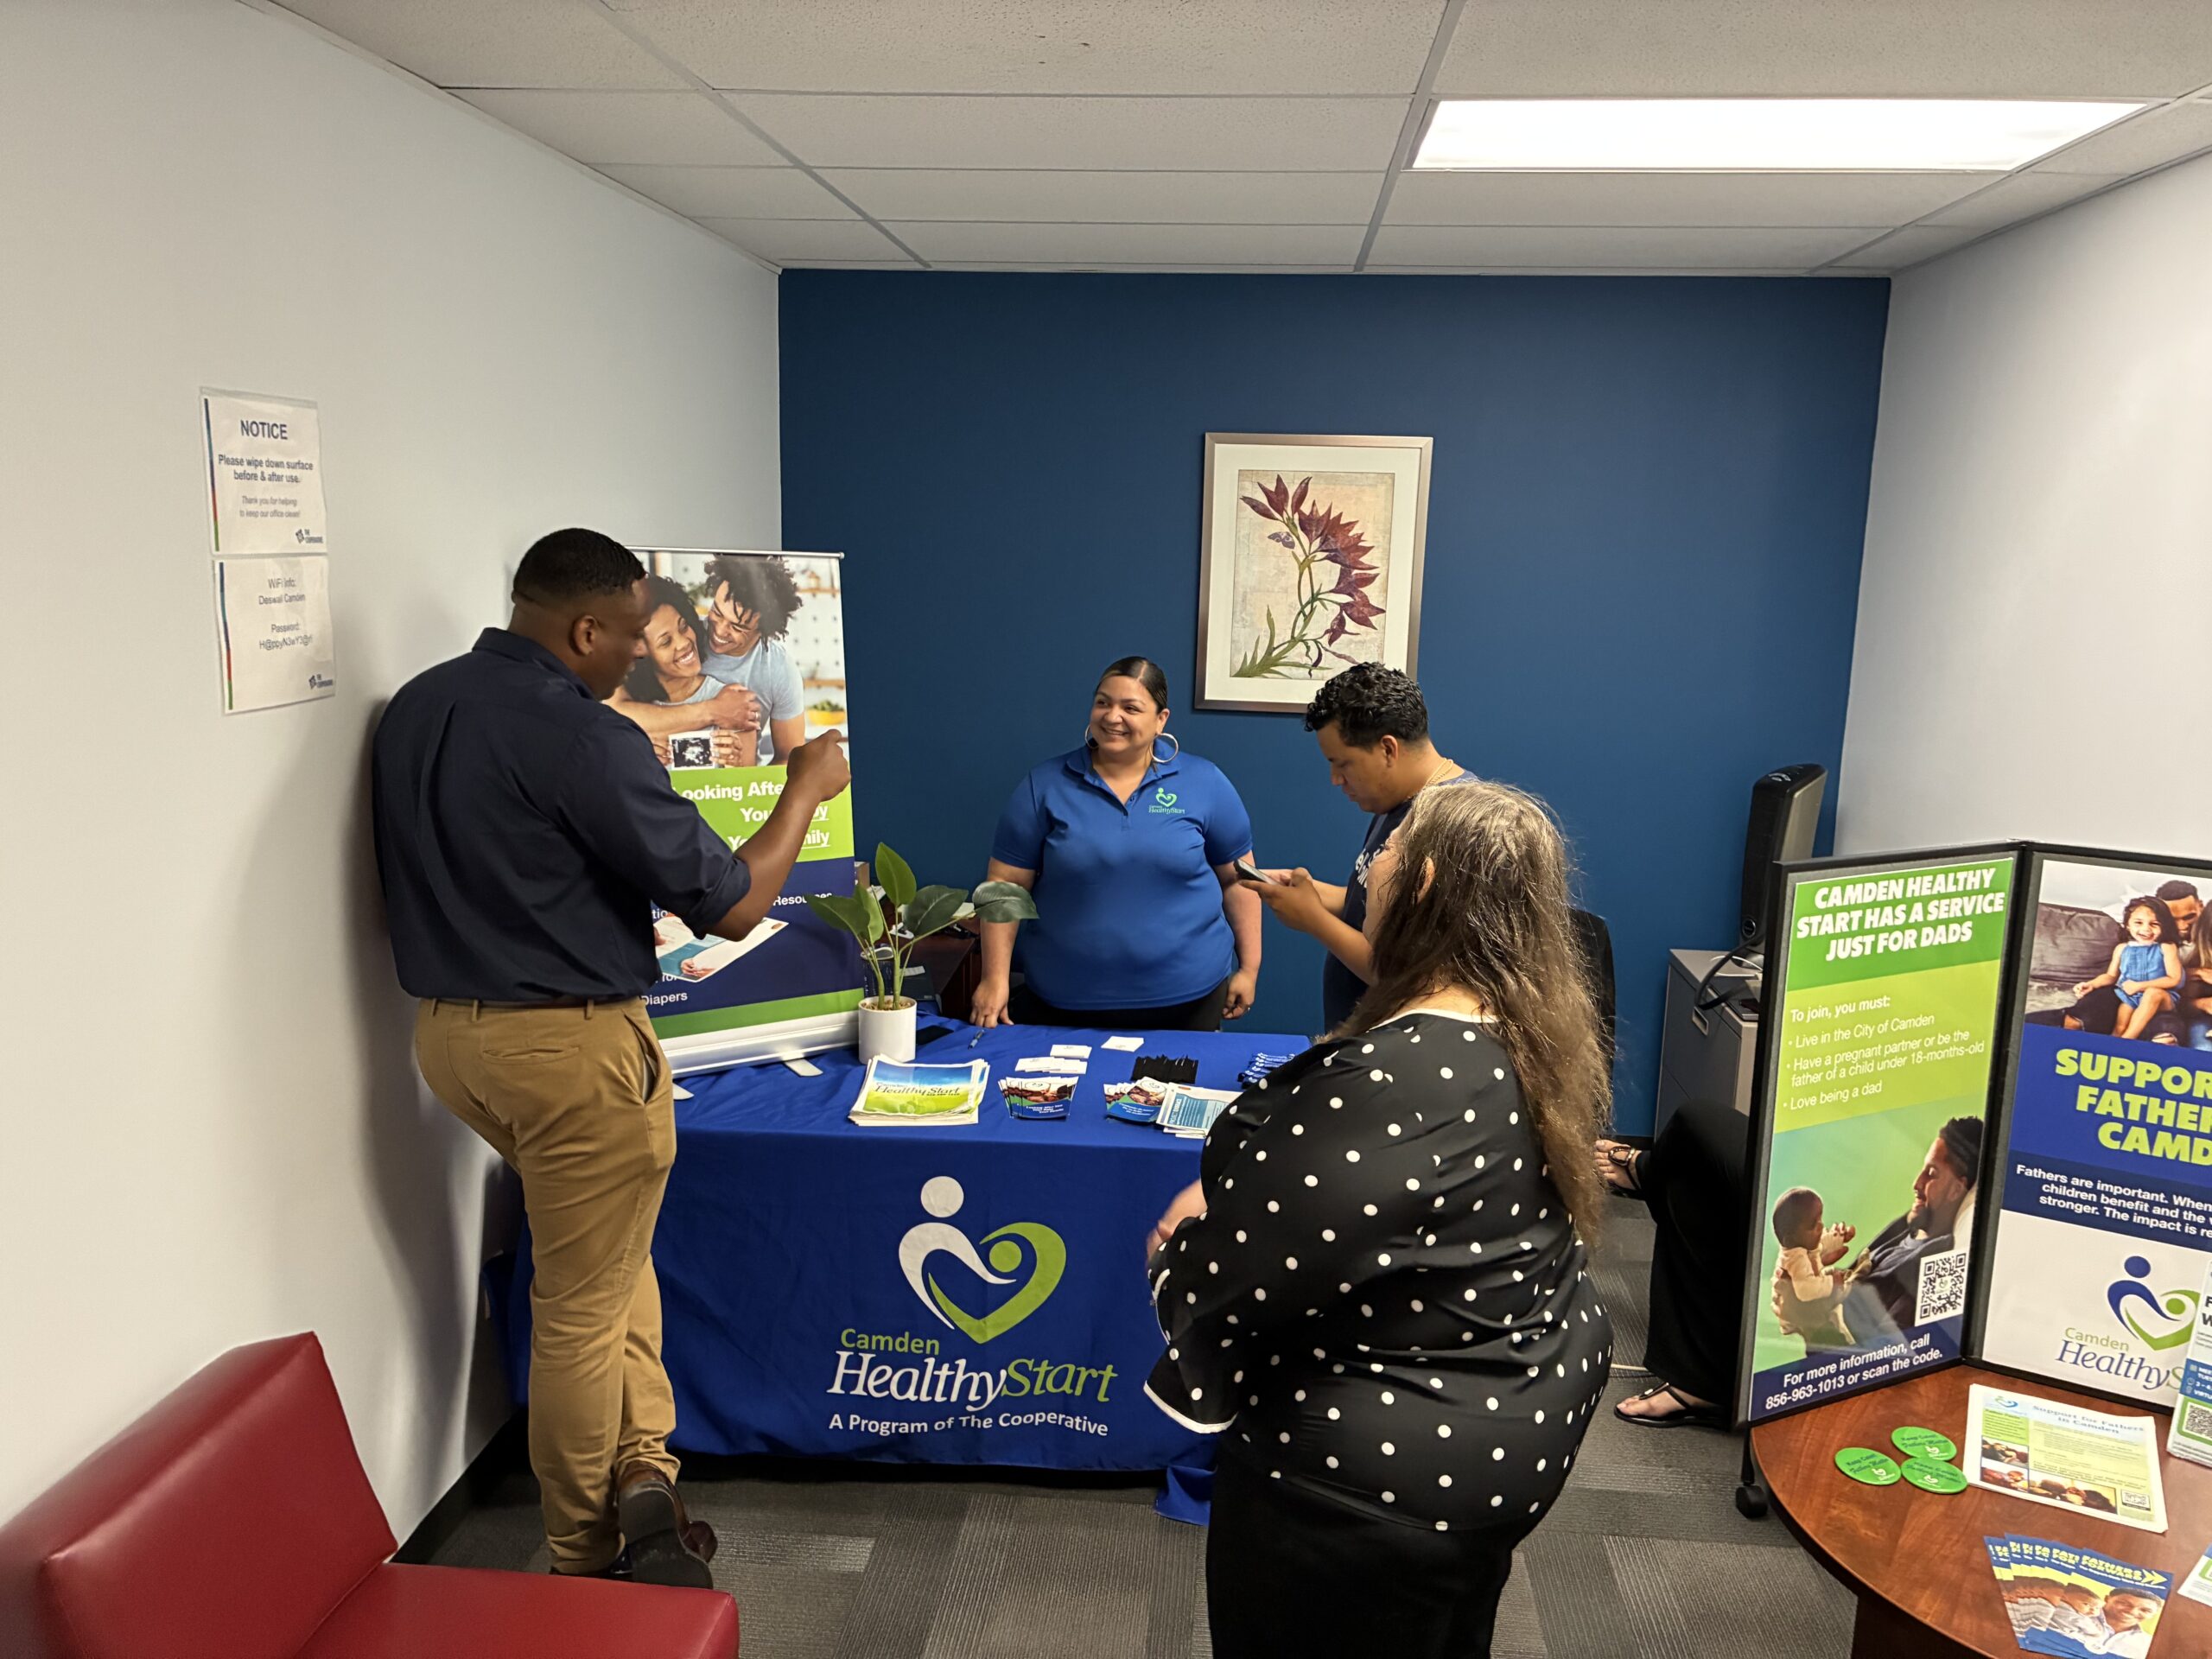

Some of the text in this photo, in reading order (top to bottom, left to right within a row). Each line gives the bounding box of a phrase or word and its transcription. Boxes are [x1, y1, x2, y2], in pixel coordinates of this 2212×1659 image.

[240, 420, 288, 440] NOTICE
[219, 454, 314, 471] Please wipe down surface
[233, 469, 257, 480] before
[260, 471, 265, 481] &
[268, 472, 283, 482] after
[242, 495, 297, 507] Thank you for helping
[245, 510, 259, 518] keep
[682, 780, 785, 801] ooking Afte
[740, 807, 772, 822] You
[1815, 868, 1996, 909] CAMDEN HEALTHY
[1796, 893, 2005, 939] START HAS A SERVICE
[1825, 921, 1973, 961] JUST FOR DADS
[1789, 995, 1891, 1023] To join, you must:
[1796, 1014, 1935, 1048] Live in the City of Camden
[1791, 1040, 1986, 1088] father of a child under 18-months-old
[1793, 1029, 1970, 1071] Have a pregnant partner or be the
[875, 1085, 926, 1096] Healthy
[1789, 1080, 1883, 1110] Love being a dad
[2016, 1164, 2069, 1184] Fathers
[2070, 1177, 2094, 1188] are
[2096, 1180, 2169, 1204] important.
[2039, 1196, 2101, 1216] stronger.
[2103, 1206, 2130, 1221] The
[2133, 1213, 2182, 1232] impact
[2184, 1220, 2197, 1235] is
[2042, 1183, 2206, 1224] children benefit and the
[841, 1328, 940, 1356] Camden
[2065, 1327, 2129, 1352] Camden
[1783, 1333, 1930, 1388] For more information, call
[2055, 1339, 2184, 1390] HealthyS
[826, 1350, 1118, 1411] HealthyStart
[1765, 1348, 1943, 1410] 856-963-1013 or scan the code.
[830, 1413, 1109, 1437] A Program of The Cooperative
[2032, 1405, 2077, 1420] Support
[2101, 1420, 2145, 1432] Fathers
[2073, 1420, 2120, 1434] Camden
